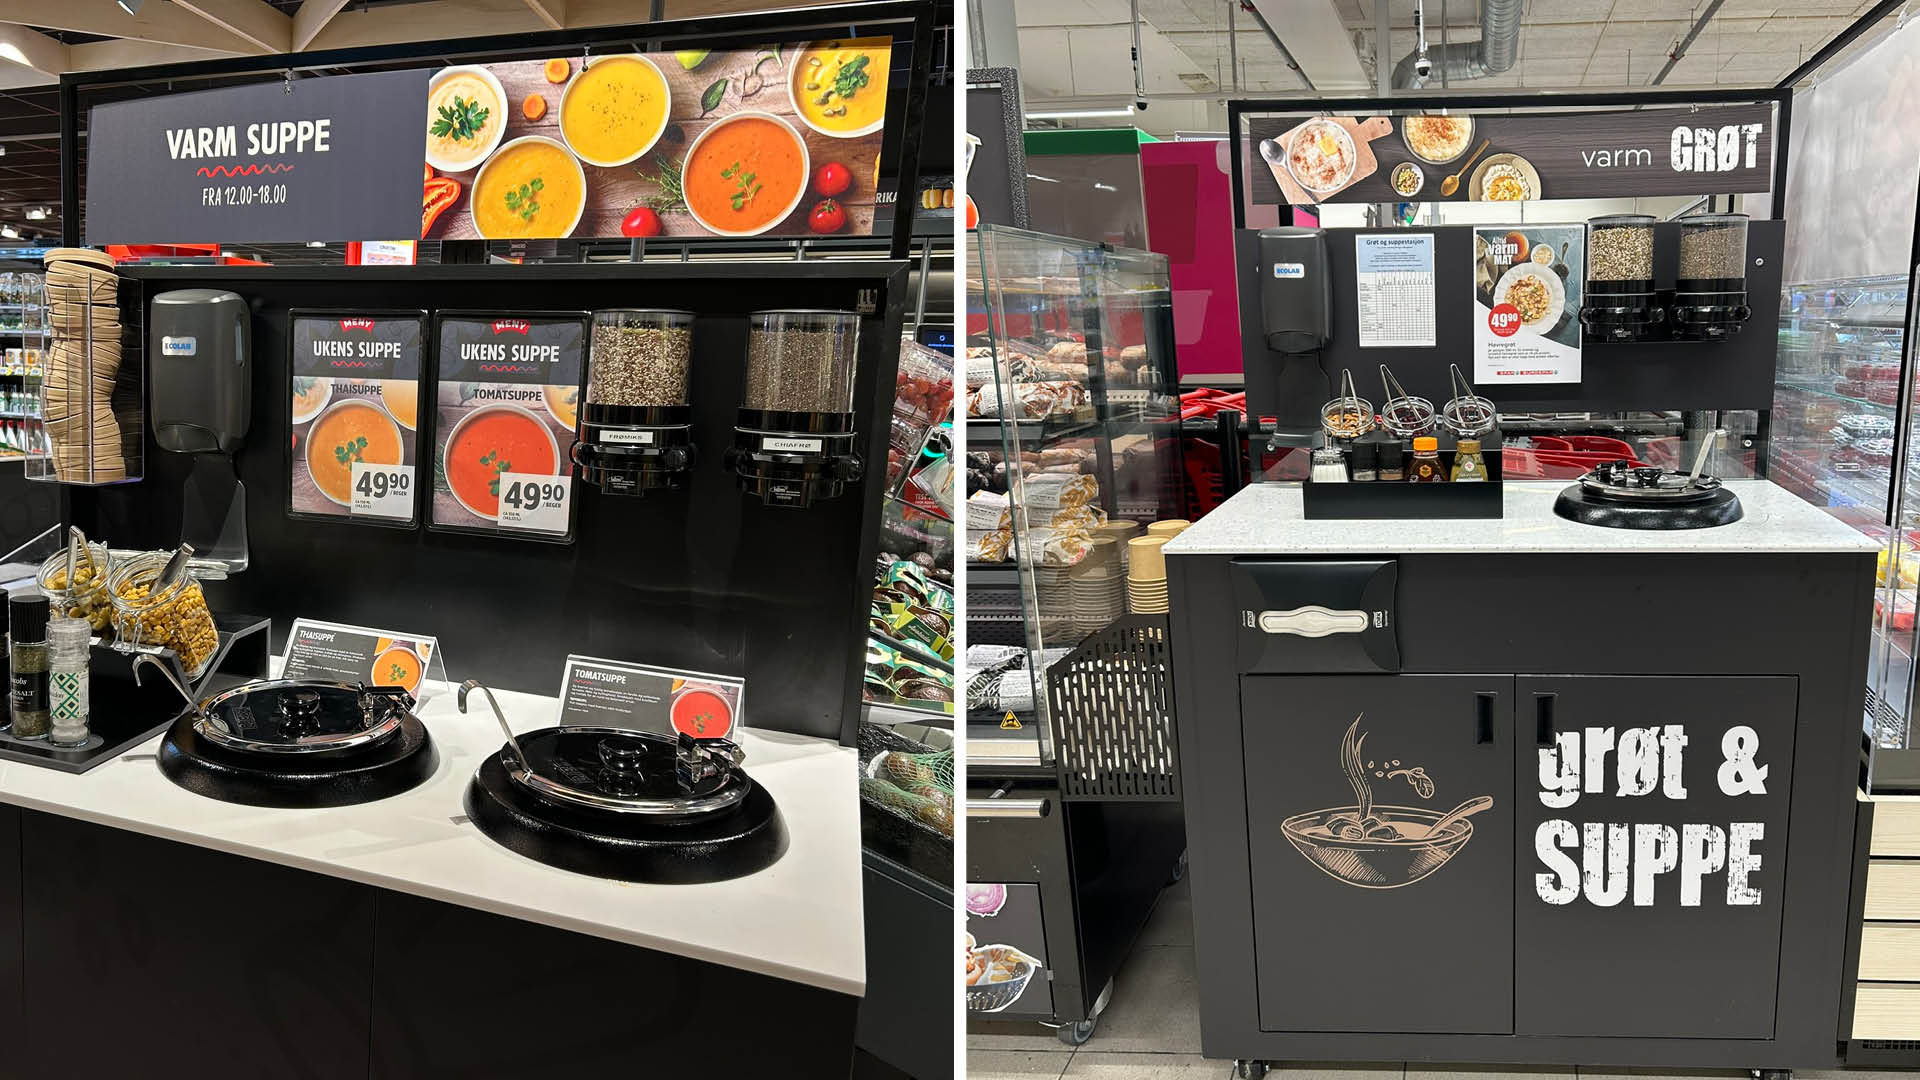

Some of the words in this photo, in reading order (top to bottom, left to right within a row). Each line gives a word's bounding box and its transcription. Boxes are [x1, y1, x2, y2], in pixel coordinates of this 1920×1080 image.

[166, 126, 236, 160] VARM
[247, 119, 331, 155] SUPPE
[1581, 148, 1652, 168] varm
[1670, 123, 1763, 173] GRØT
[202, 186, 222, 206] FRA
[224, 184, 287, 206] 12.00-18.00
[1488, 243, 1518, 255] varm
[1494, 254, 1513, 265] MAT
[1276, 267, 1300, 275] ECOLAB
[344, 318, 372, 328] MENY
[496, 319, 527, 331] MENY
[313, 340, 354, 357] UKENS
[358, 342, 401, 358] SUPPE
[461, 343, 506, 361] UKENS
[511, 345, 560, 362] SUPPE
[330, 383, 382, 396] THAISUPPE
[473, 388, 542, 402] TOMATSUPPE
[299, 630, 336, 643] THAISUPPE
[575, 668, 627, 685] TOMATSUPPE
[1538, 724, 1688, 808] grøt
[1717, 725, 1769, 795] &
[1534, 819, 1765, 907] SUPPE
